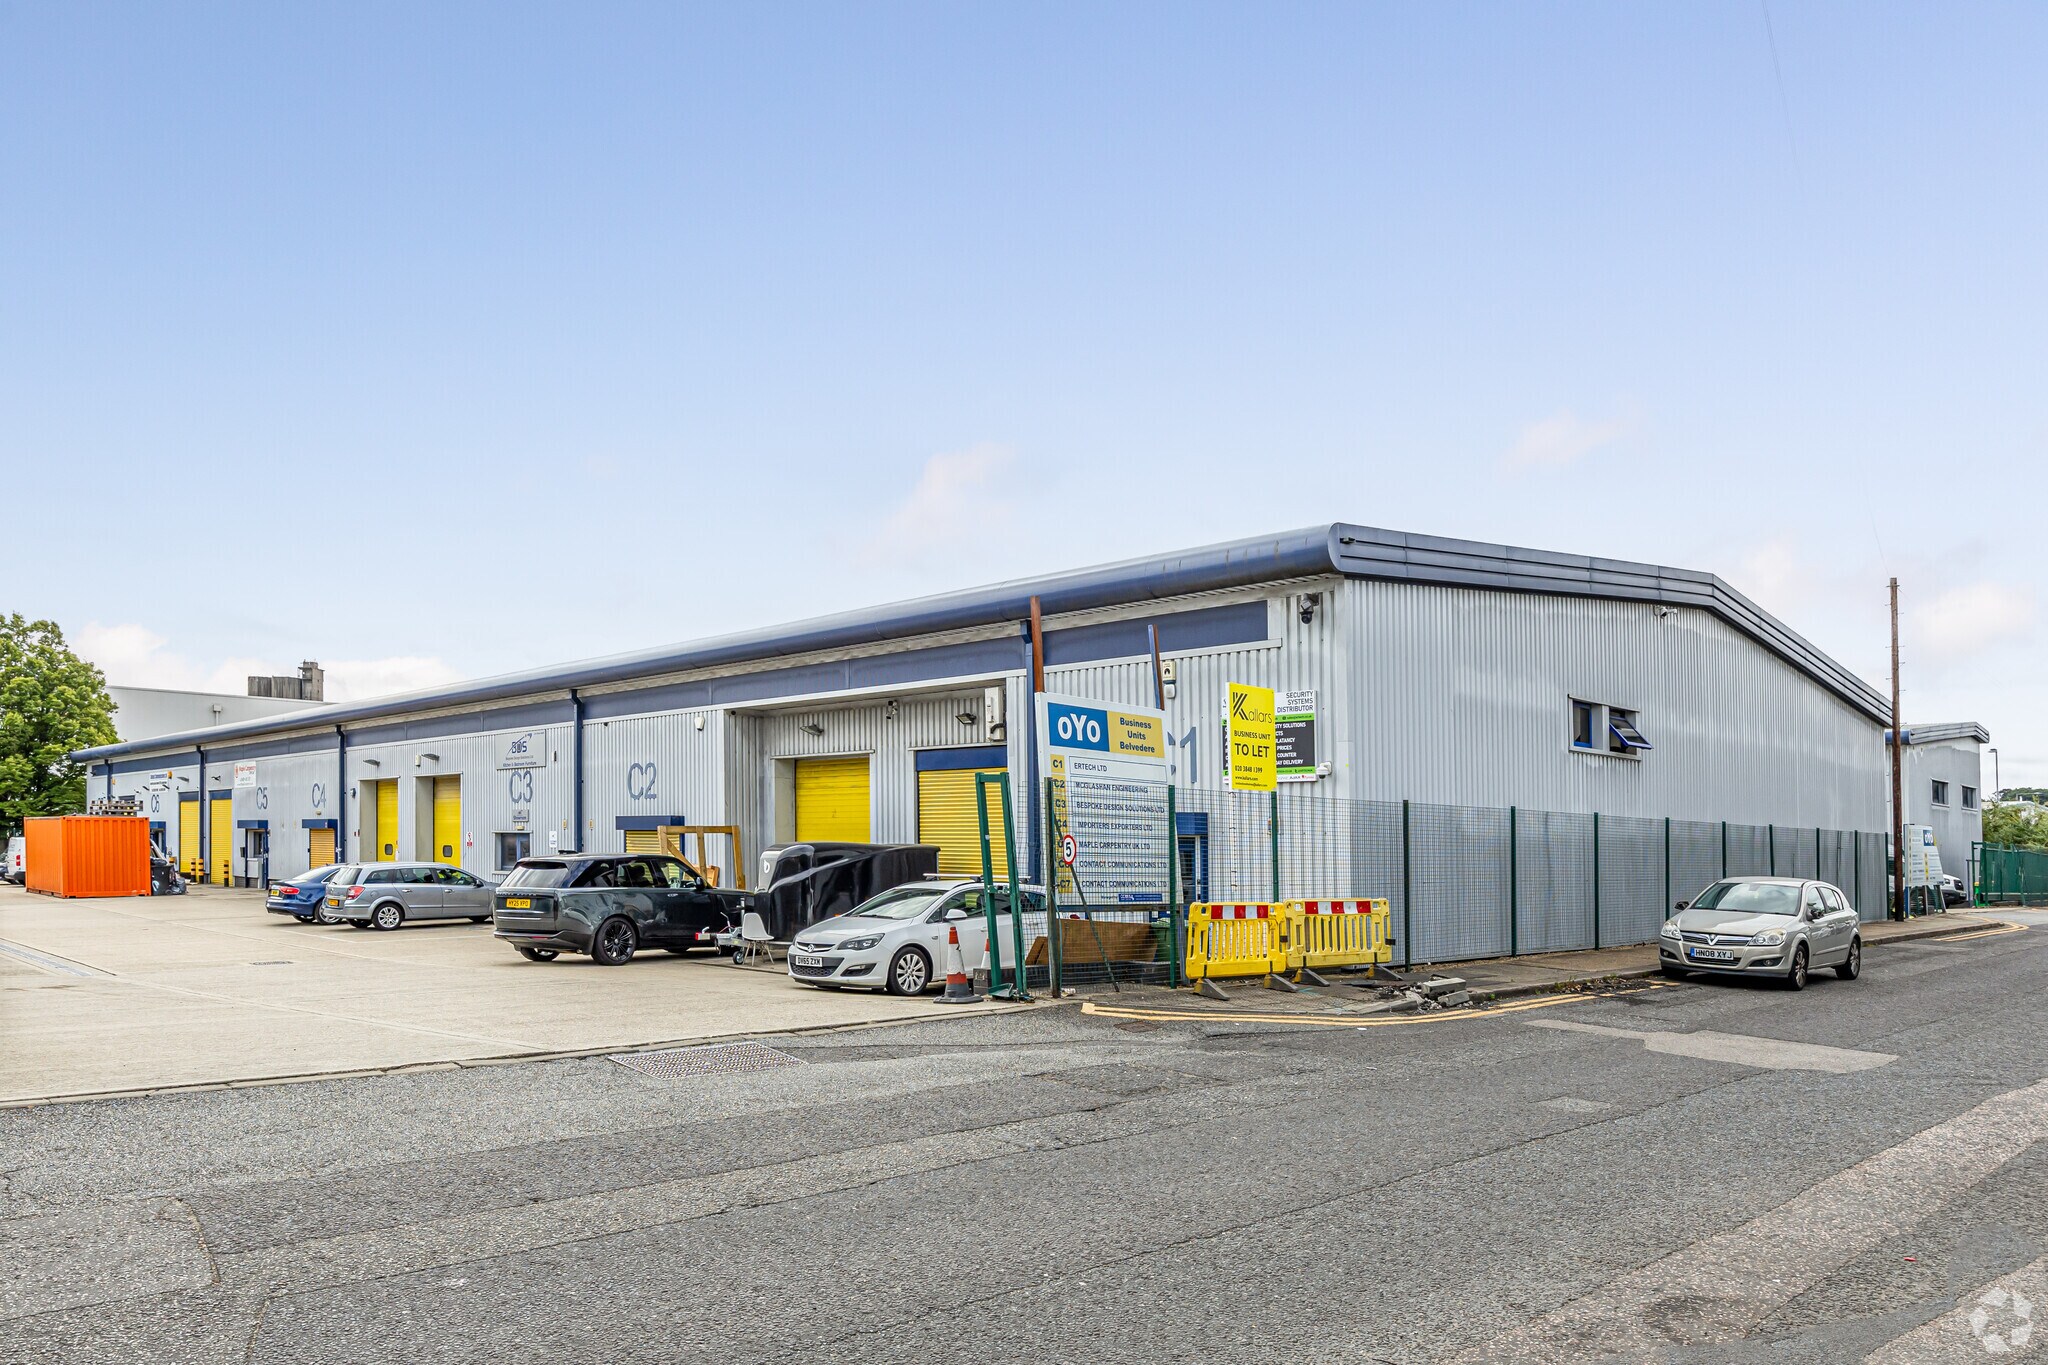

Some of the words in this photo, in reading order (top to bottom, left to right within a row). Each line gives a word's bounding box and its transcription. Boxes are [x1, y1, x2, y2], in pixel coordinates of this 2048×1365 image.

[1276, 704, 1314, 713] DISTRIBUTOR
[1120, 717, 1152, 730] Business
[1127, 730, 1146, 740] Units
[1234, 730, 1257, 739] BUSINESS
[1120, 741, 1156, 753] Belvedere
[1234, 743, 1249, 756] TO
[1252, 745, 1270, 758] LET
[1052, 760, 1063, 768] C1
[1074, 762, 1096, 771] ERTECH
[510, 770, 533, 803] C3
[628, 762, 656, 800] C2
[1054, 780, 1065, 788] C2
[1076, 782, 1111, 791] MCGLASHAN
[1112, 784, 1148, 793] ENGINEERING
[256, 787, 268, 809] C5
[312, 783, 326, 808] C4
[1056, 799, 1066, 808] C3
[1077, 801, 1103, 810] BESPOKE
[1104, 803, 1124, 811] DESIGN
[1125, 804, 1155, 813] SOLUTIONS
[1057, 820, 1067, 828] C4
[1078, 822, 1109, 830] IMPORTERS
[1111, 822, 1142, 831] EXPORTERS
[1066, 842, 1071, 857] 5
[1060, 880, 1070, 888] C7
